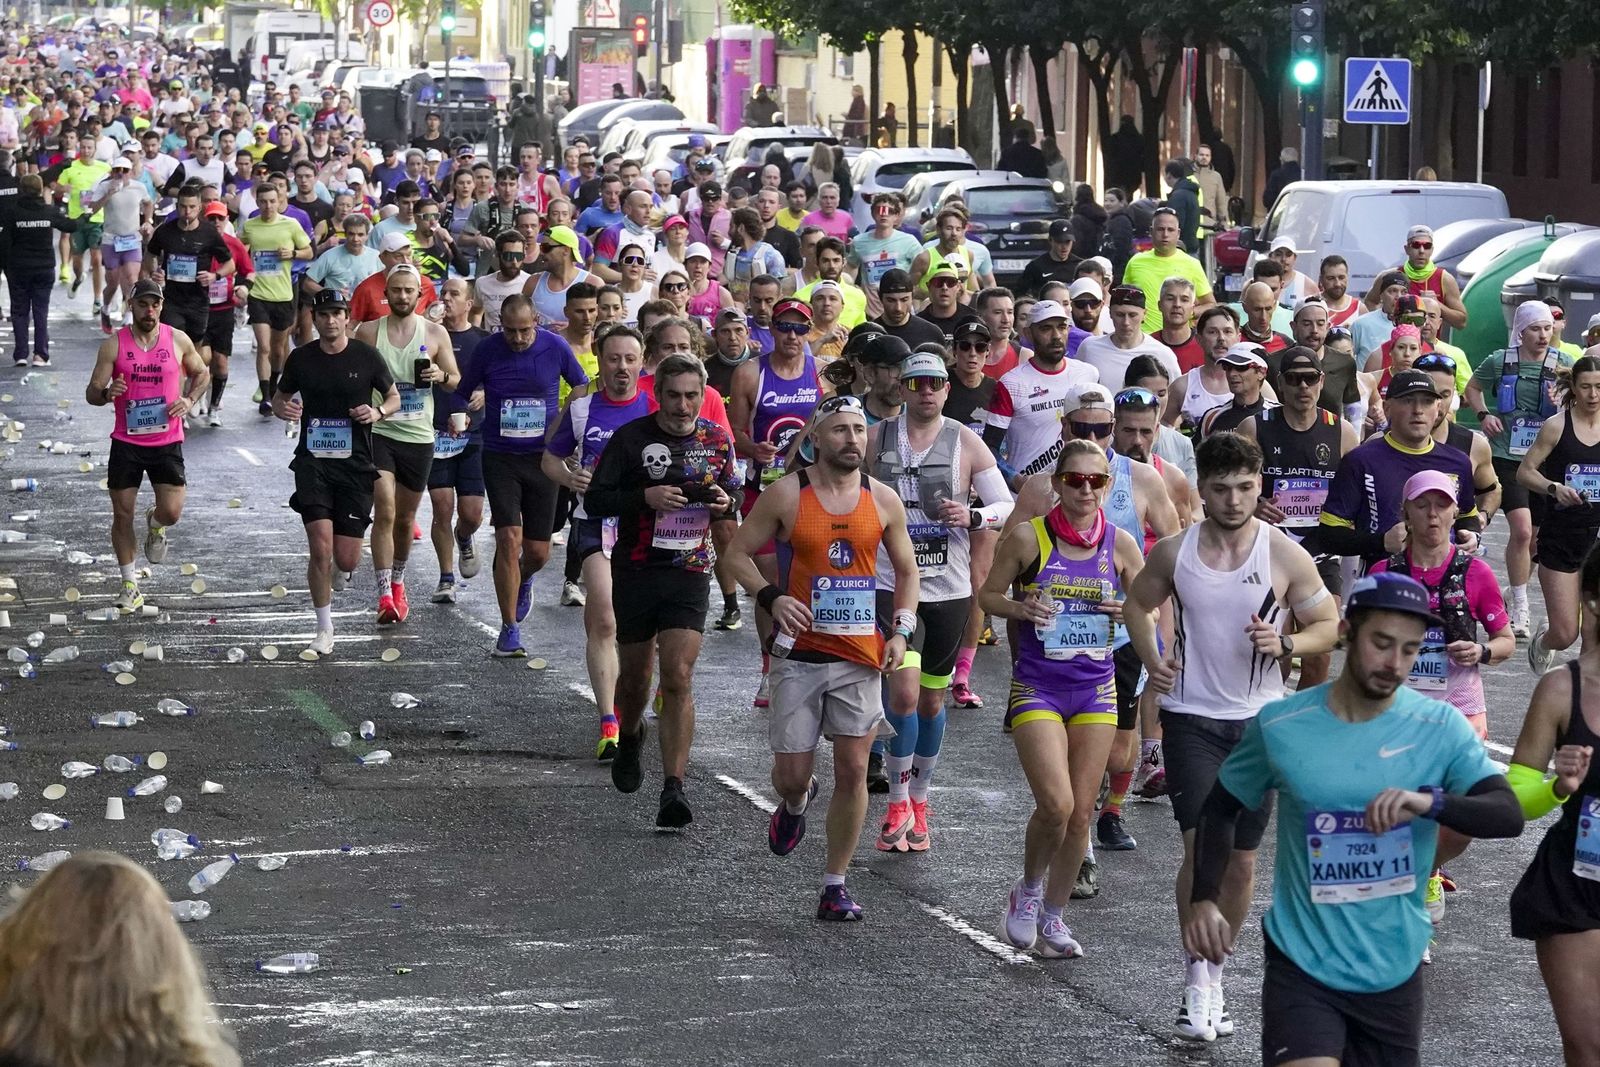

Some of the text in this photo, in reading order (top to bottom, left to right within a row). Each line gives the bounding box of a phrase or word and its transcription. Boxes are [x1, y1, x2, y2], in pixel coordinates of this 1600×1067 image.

[373, 8, 389, 18] 30
[16, 220, 51, 228] VOLUNTEER
[132, 363, 162, 373] Triatlón
[131, 374, 163, 385] Pisuerga
[797, 388, 818, 397] Taller
[138, 398, 162, 406] ZURICH
[762, 390, 817, 407] Quintana
[400, 402, 425, 411] NTINOS
[1031, 401, 1053, 412] NUNCA
[137, 417, 158, 426] BUEY
[312, 439, 347, 448] IGNACIO
[1262, 467, 1336, 479] LOS JARTIBLES
[1290, 495, 1310, 503] 12256
[654, 528, 678, 538] JUAN
[835, 580, 869, 588] ZURICH
[1050, 574, 1070, 585] ELS
[835, 597, 855, 605] 6173
[1069, 602, 1099, 612] ZURIC
[814, 609, 875, 621] JESUS G.S.
[1070, 621, 1087, 629] 7154
[1060, 633, 1098, 646] AGATA
[1411, 660, 1442, 675] ANIE
[1346, 843, 1377, 855] 7924
[1312, 855, 1411, 881] XANKLY 11
